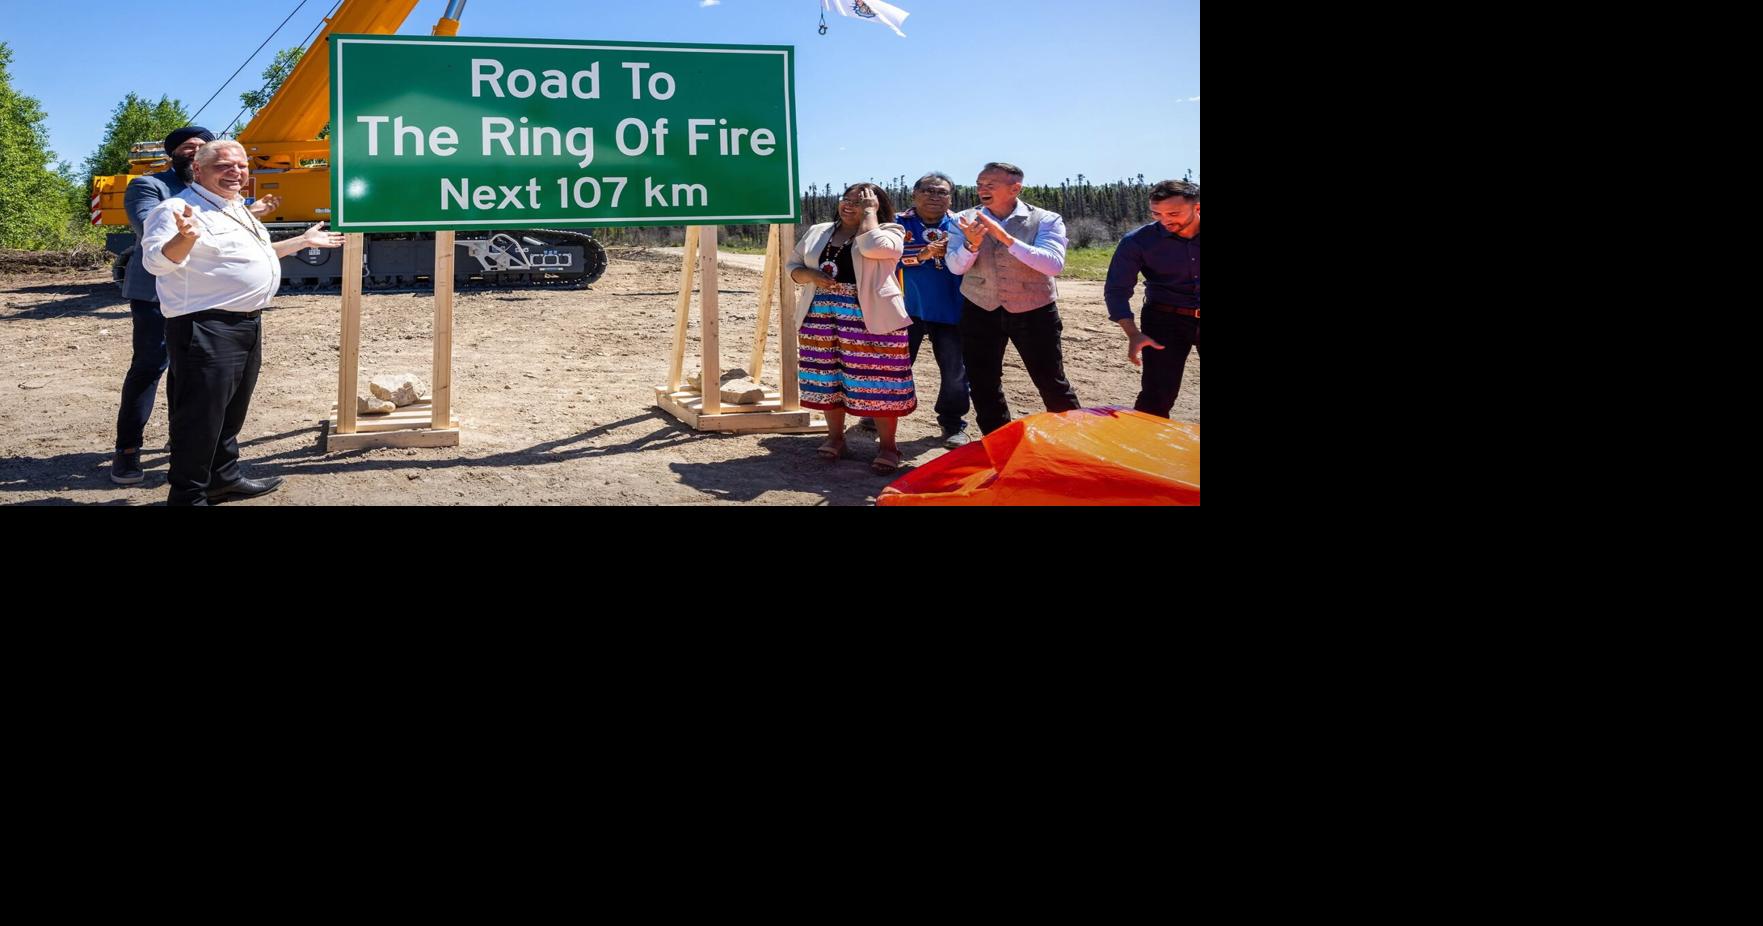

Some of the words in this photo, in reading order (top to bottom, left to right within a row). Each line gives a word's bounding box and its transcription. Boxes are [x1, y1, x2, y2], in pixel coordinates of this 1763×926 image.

[471, 58, 600, 99] Road
[622, 62, 676, 100] To
[356, 115, 459, 157] The
[481, 116, 594, 169] Ring
[615, 117, 668, 156] Of
[688, 118, 776, 156] Fire
[441, 177, 541, 210] Next
[557, 176, 628, 209] 107
[645, 176, 708, 207] km
